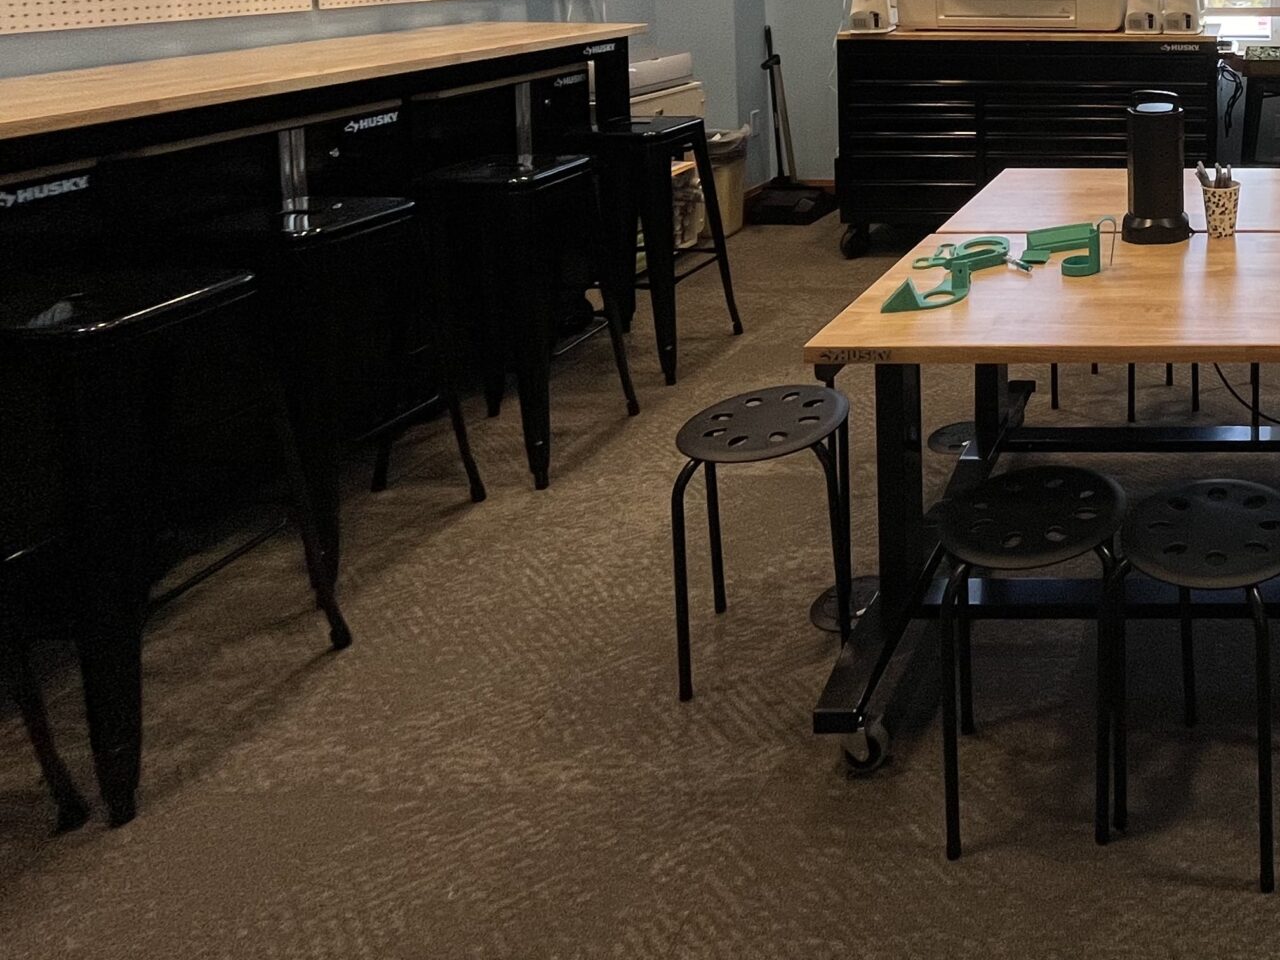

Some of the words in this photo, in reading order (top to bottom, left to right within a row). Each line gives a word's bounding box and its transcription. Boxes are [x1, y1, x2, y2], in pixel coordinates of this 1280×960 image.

[590, 43, 616, 54] HUSKY
[359, 111, 399, 130] HUSKY
[16, 175, 90, 203] HUSKY
[838, 349, 892, 361] HUSKY
